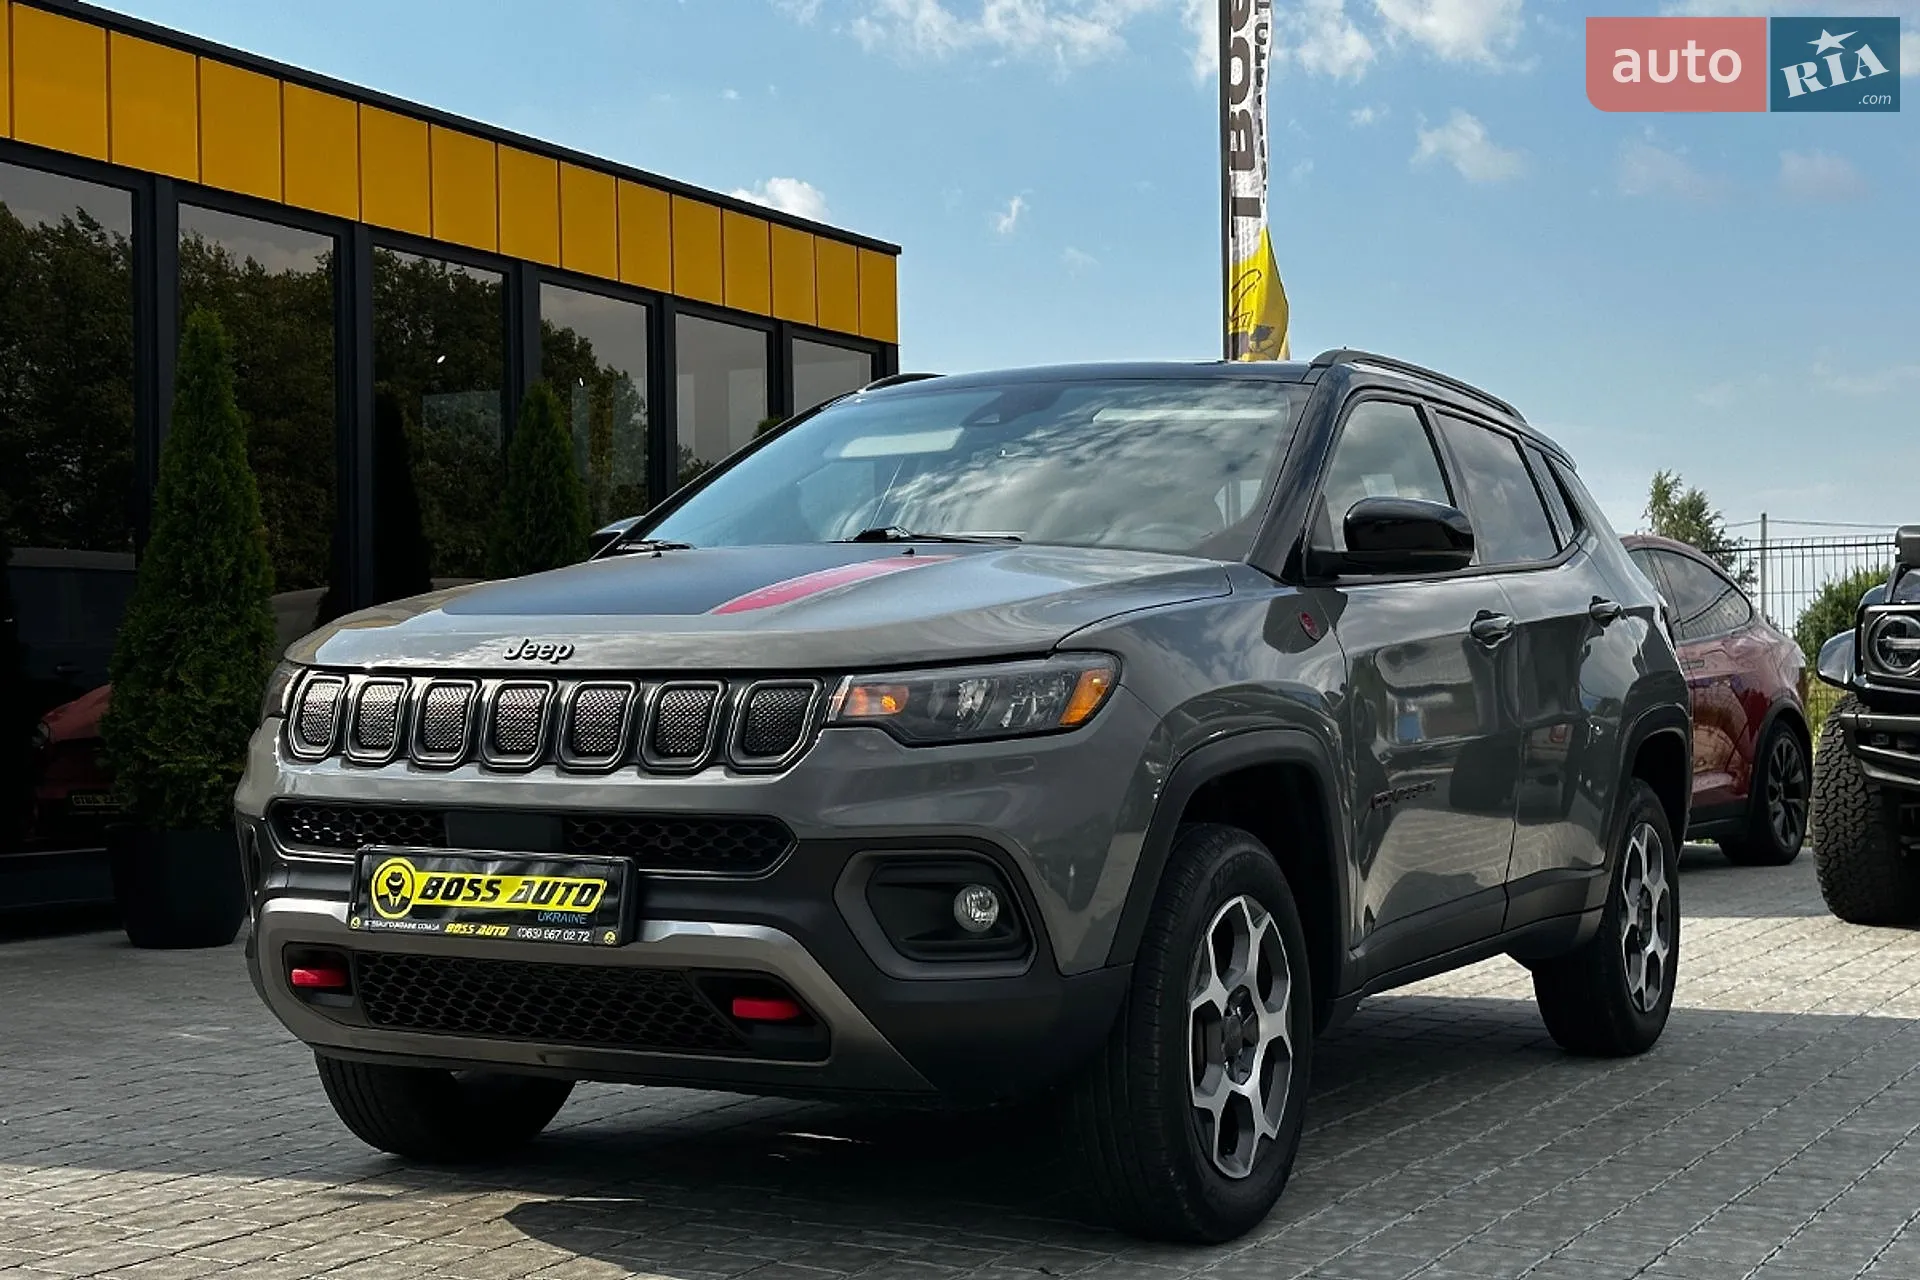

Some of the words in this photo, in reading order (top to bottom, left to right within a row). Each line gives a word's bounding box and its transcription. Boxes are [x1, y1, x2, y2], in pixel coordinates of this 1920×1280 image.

[503, 637, 575, 665] Jeep
[418, 876, 502, 902] BOSS
[505, 880, 601, 906] AUTO
[537, 911, 588, 925] UKRAINE
[444, 923, 476, 934] BOSS
[475, 924, 510, 936] AUTO
[563, 930, 576, 941] 02
[577, 931, 591, 942] 72
